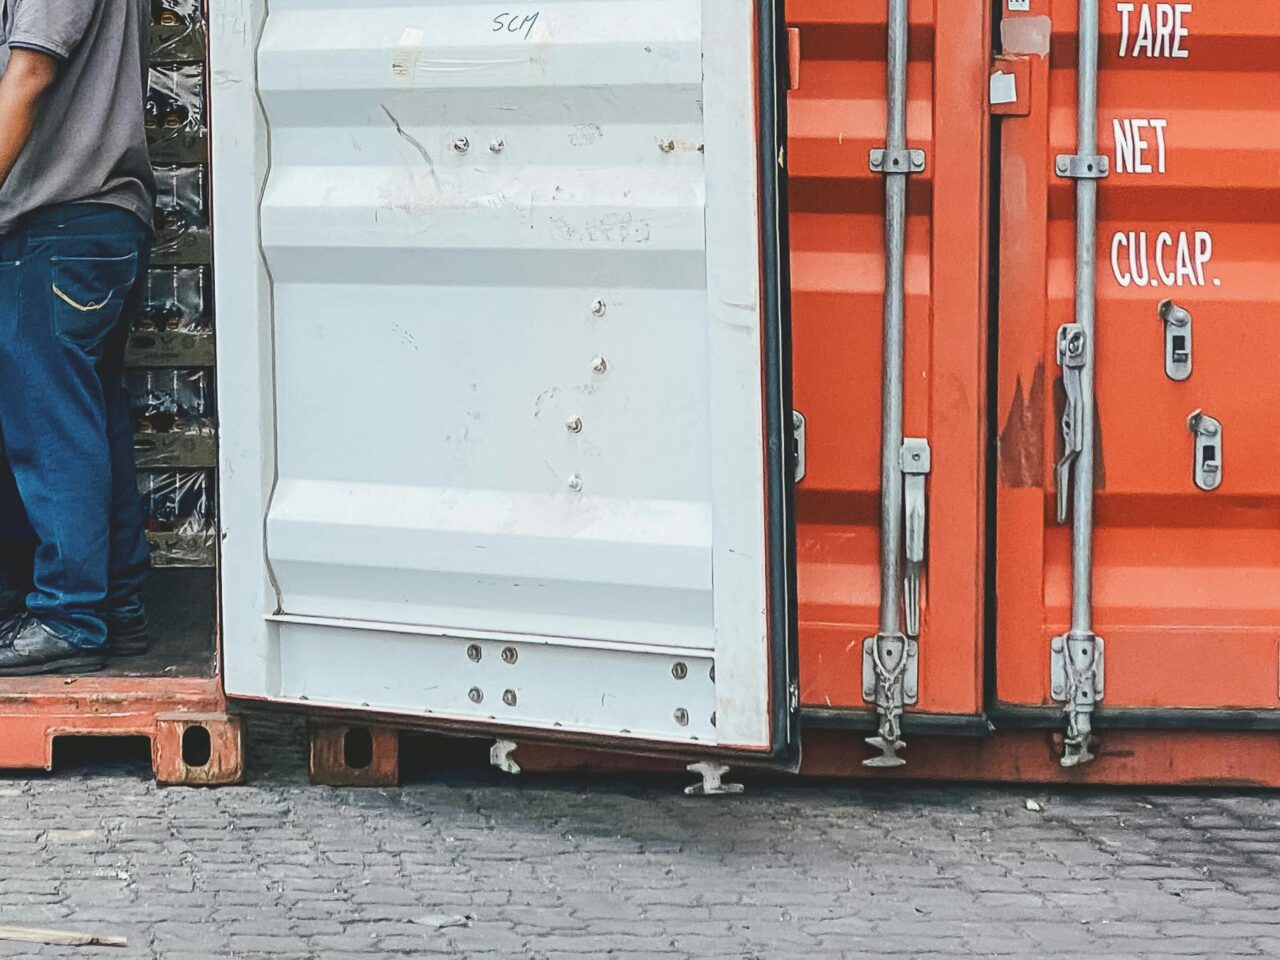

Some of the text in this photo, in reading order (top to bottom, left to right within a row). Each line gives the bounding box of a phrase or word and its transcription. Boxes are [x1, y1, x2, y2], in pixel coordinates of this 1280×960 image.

[1116, 3, 1193, 58] TARE
[1112, 118, 1167, 174] NET
[1110, 231, 1222, 287] CU.CAP.
